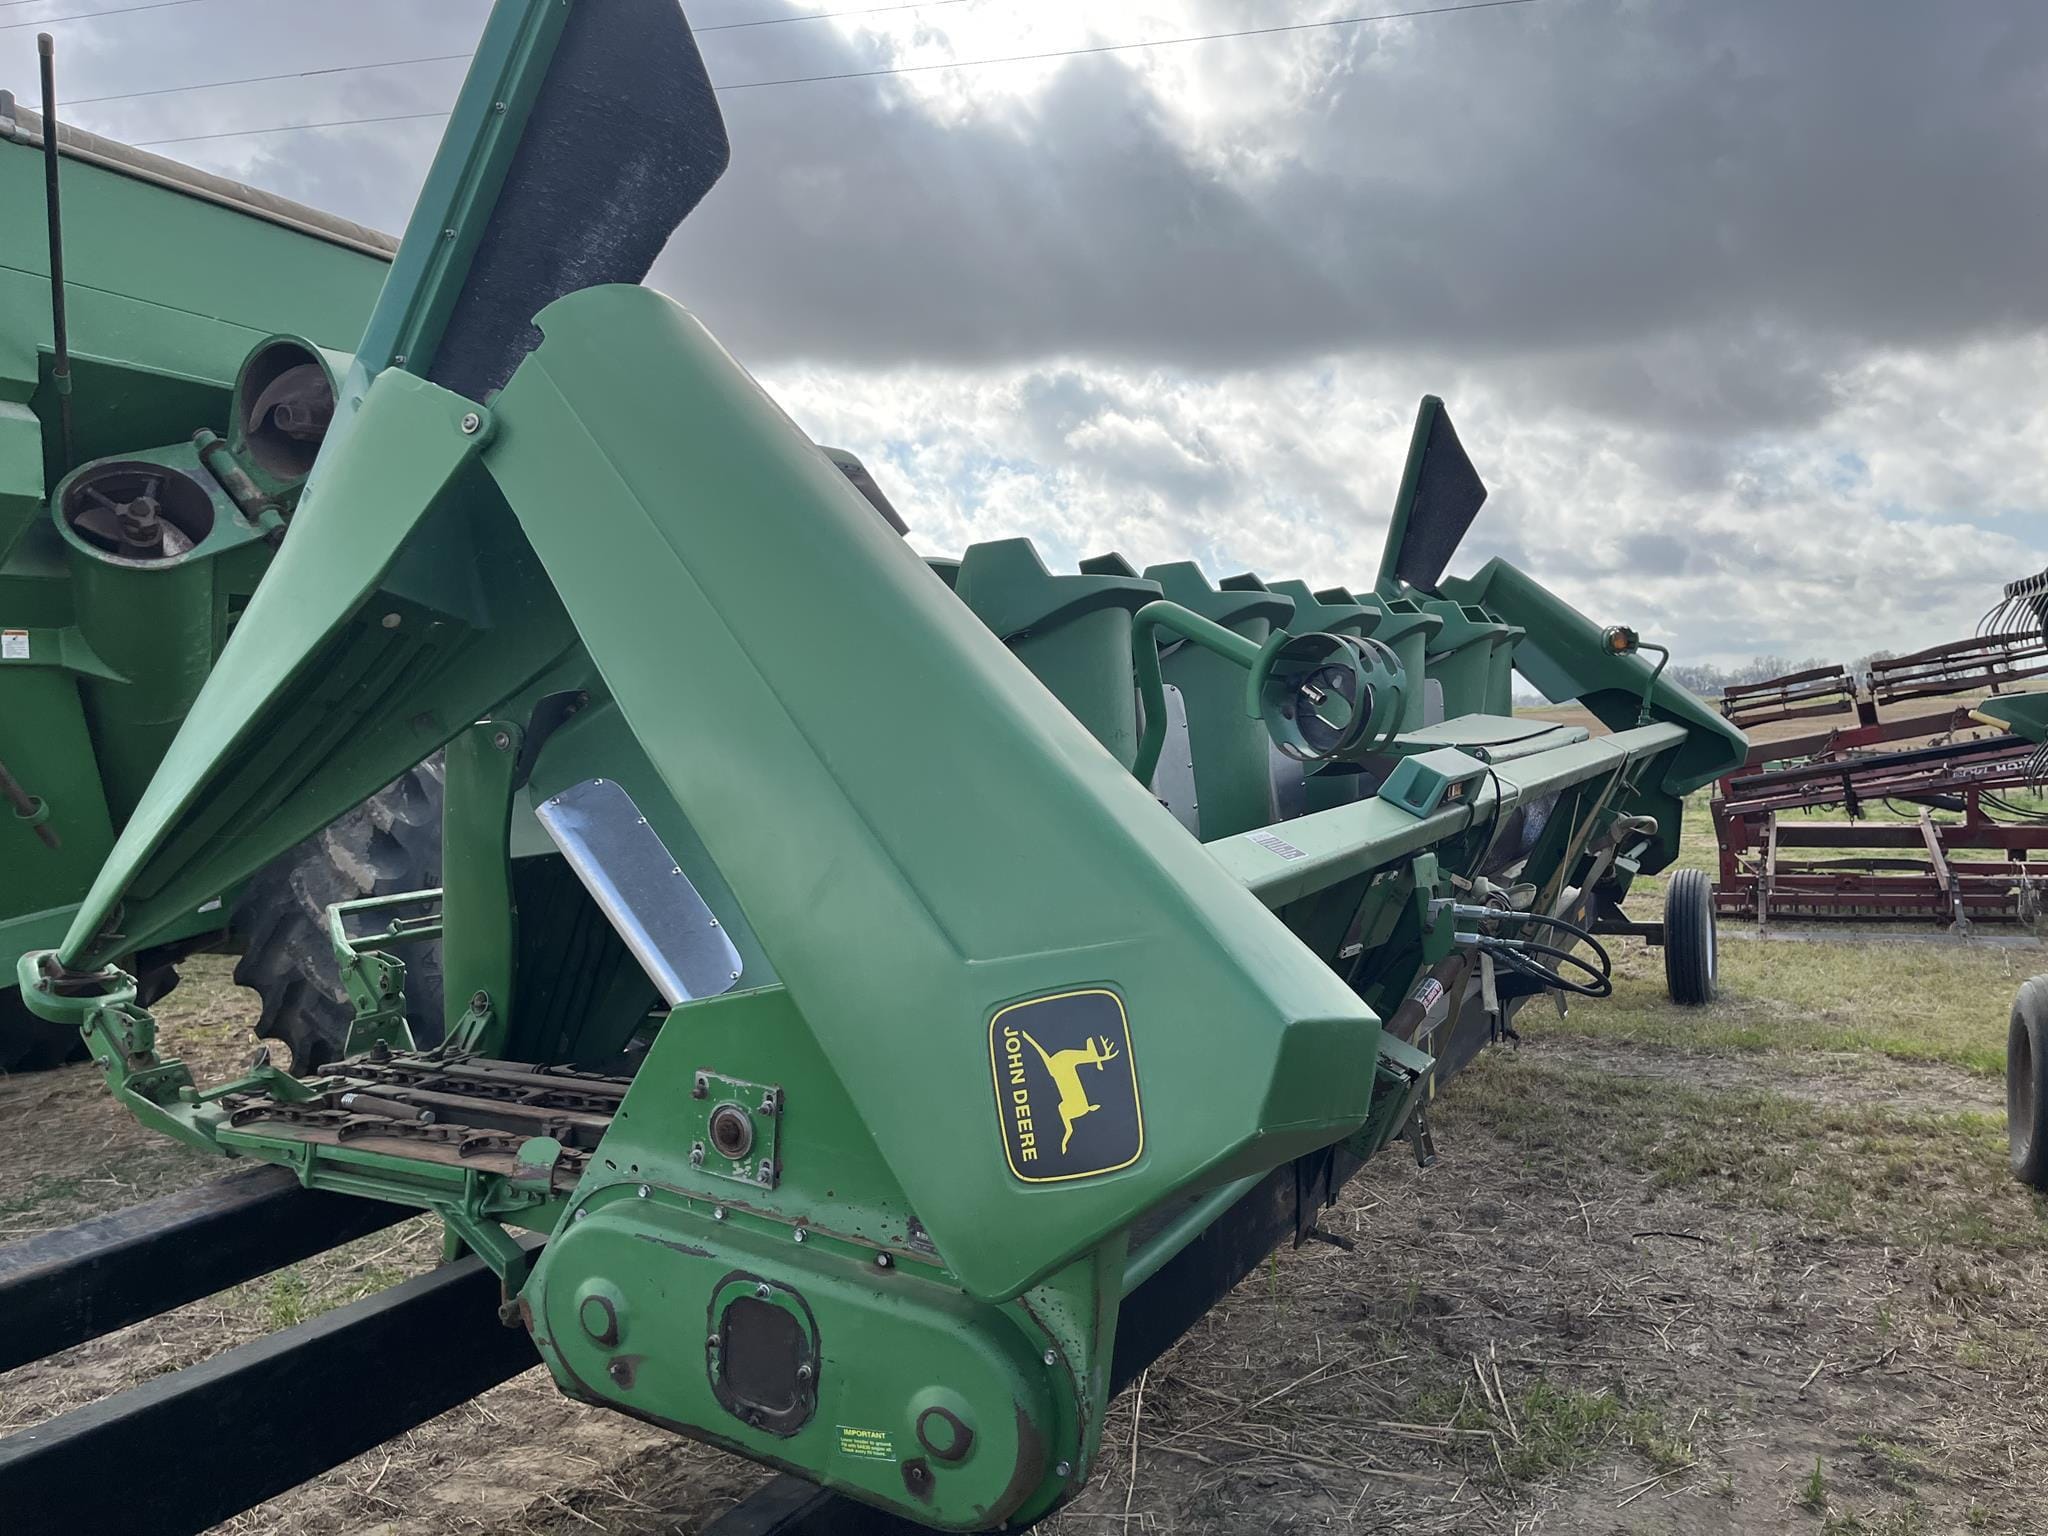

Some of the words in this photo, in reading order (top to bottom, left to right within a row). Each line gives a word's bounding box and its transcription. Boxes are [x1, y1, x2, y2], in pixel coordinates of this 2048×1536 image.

[1003, 1026, 1026, 1085] JOHN
[1012, 1089, 1039, 1162] DEERE
[843, 1428, 886, 1439] IMPORTANT
